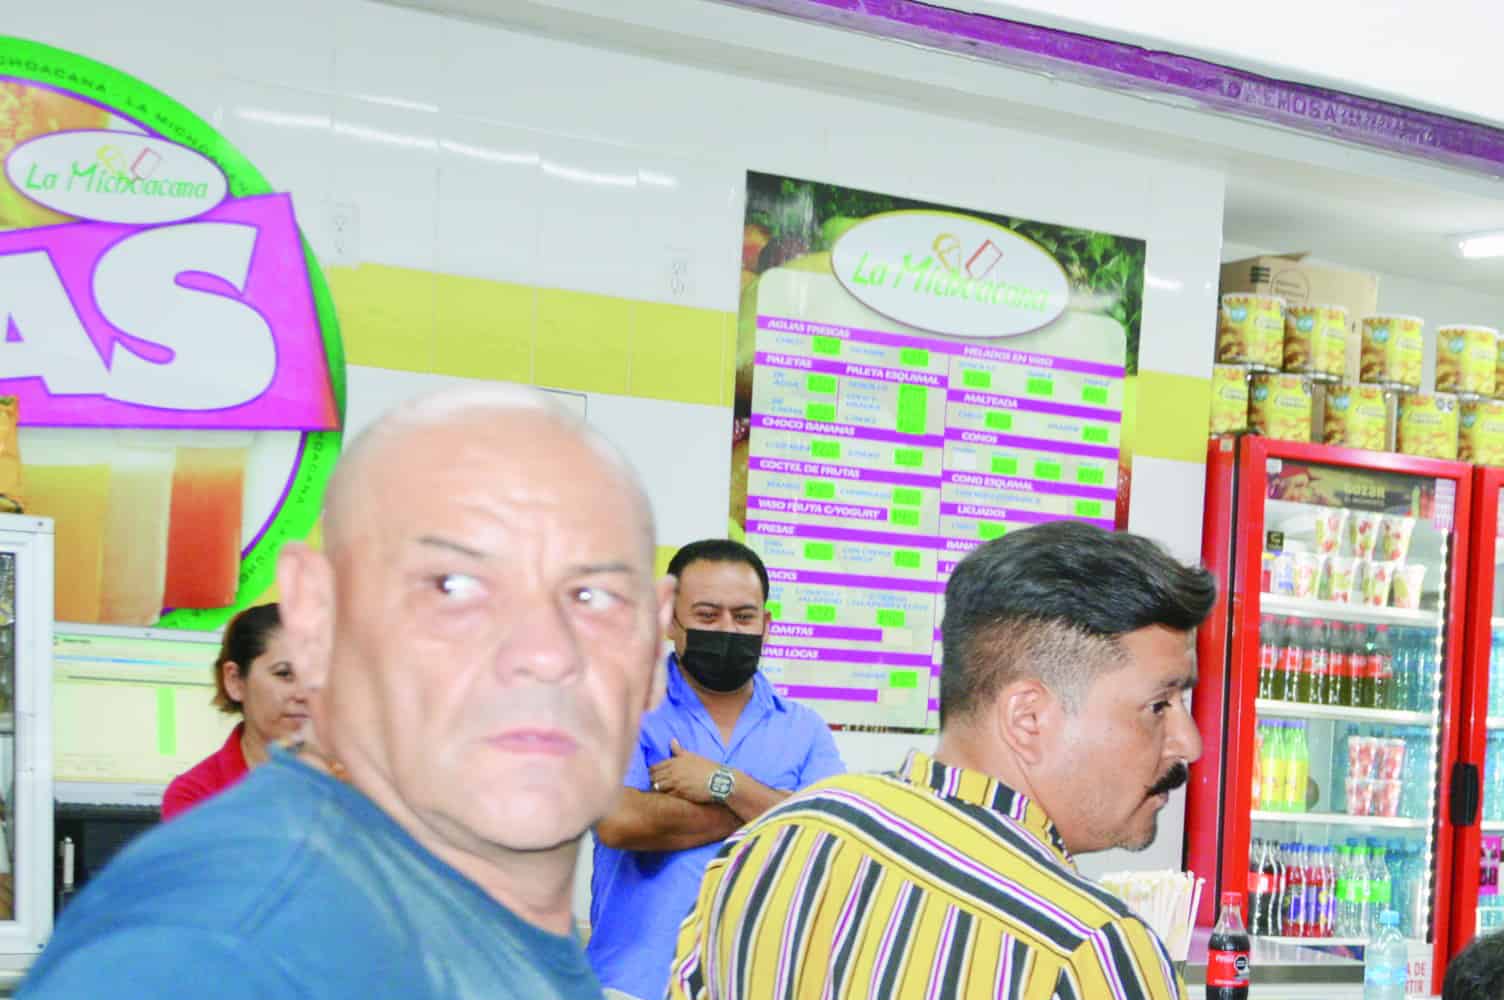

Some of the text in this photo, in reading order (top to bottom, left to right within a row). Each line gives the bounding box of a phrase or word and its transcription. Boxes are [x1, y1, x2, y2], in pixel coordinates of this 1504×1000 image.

[0, 56, 107, 92] HOACANA
[25, 159, 209, 200] La Michoacana
[851, 250, 888, 286] La
[767, 318, 851, 338] AGUAS FRESCAS
[765, 354, 813, 369] PALETAS
[963, 345, 1012, 362] HELADOS
[1012, 351, 1028, 364] EN
[845, 365, 941, 386] PALETA ESQUIMAL
[963, 393, 1018, 409] MALTEADA
[761, 416, 856, 436] CHOCO BANANAS
[961, 431, 998, 444] CONOS
[758, 459, 861, 478] COCTEL DE FRUTAS
[951, 474, 1034, 491] CONO ESQUIMAL
[757, 498, 786, 511] VASO
[786, 500, 822, 514] FRUTA
[957, 503, 1007, 518] LICUADOS
[756, 522, 796, 535] FRESAS
[769, 625, 814, 637] OMITAS
[784, 647, 819, 659] LOCAS
